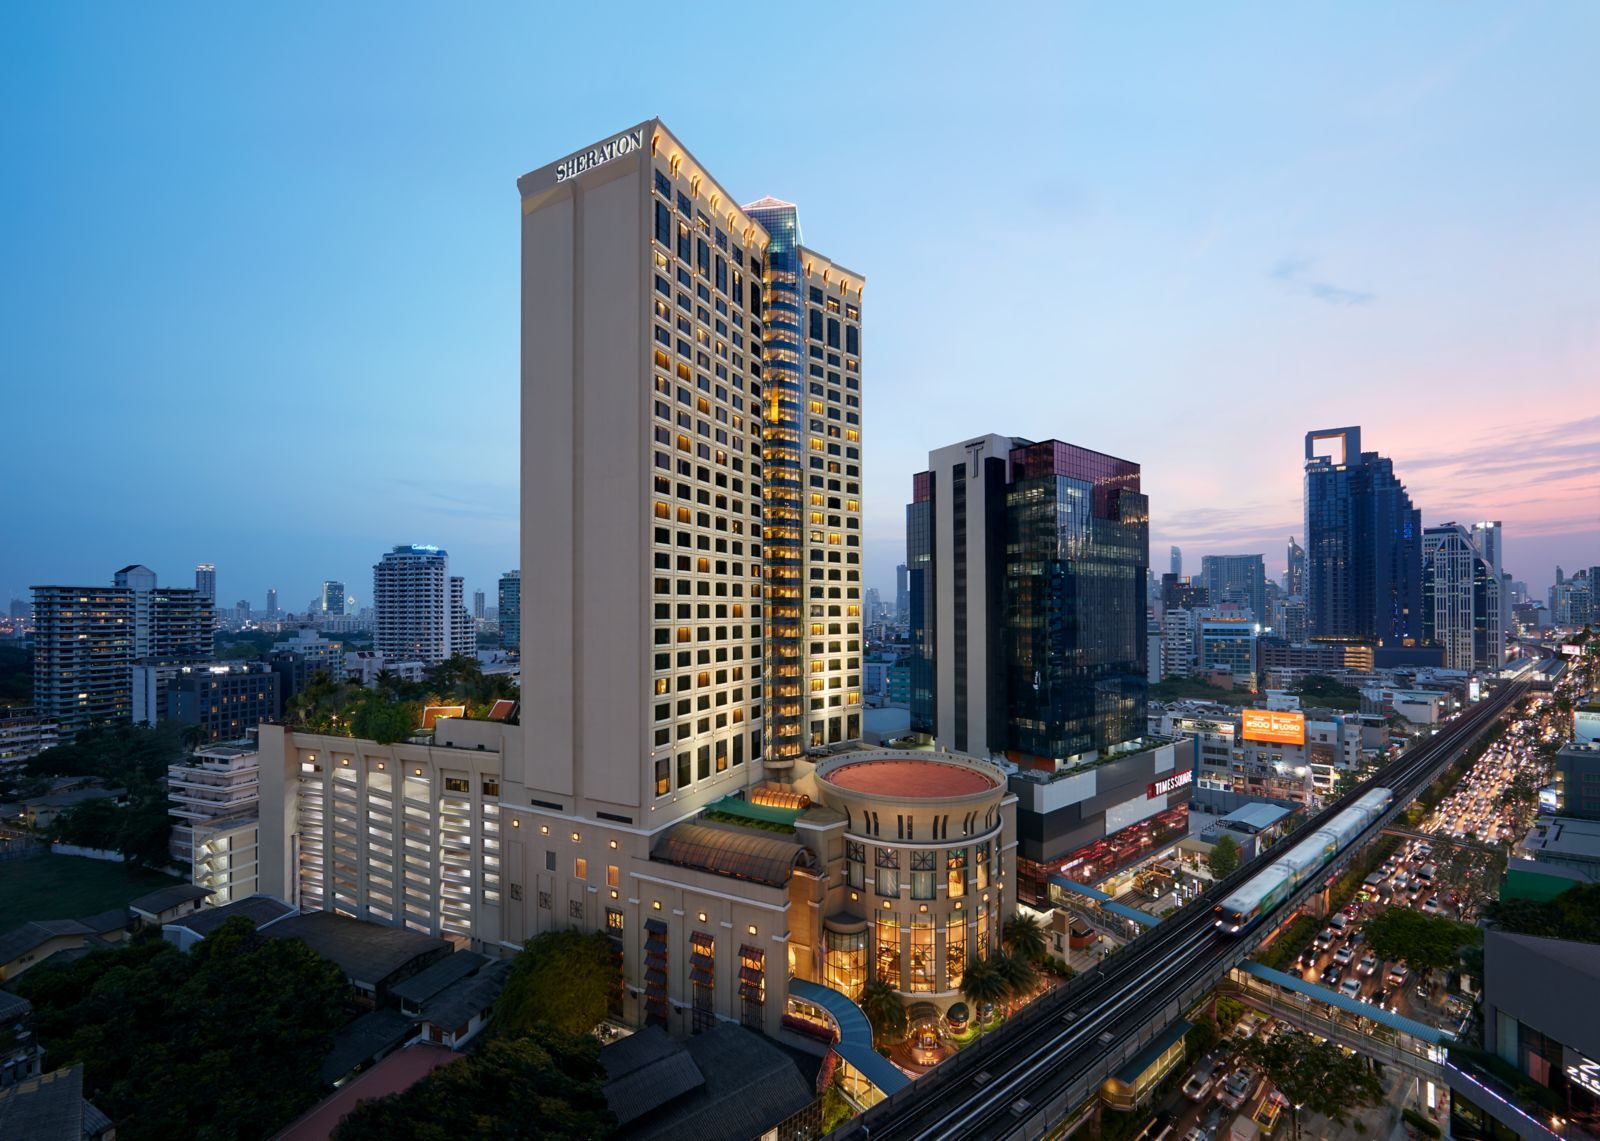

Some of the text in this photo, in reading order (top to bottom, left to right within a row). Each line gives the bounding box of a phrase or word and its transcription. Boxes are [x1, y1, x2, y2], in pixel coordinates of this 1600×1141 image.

[556, 129, 643, 183] SHERATON
[1155, 777, 1175, 796] TIMES
[1174, 770, 1192, 788] SQUARE
